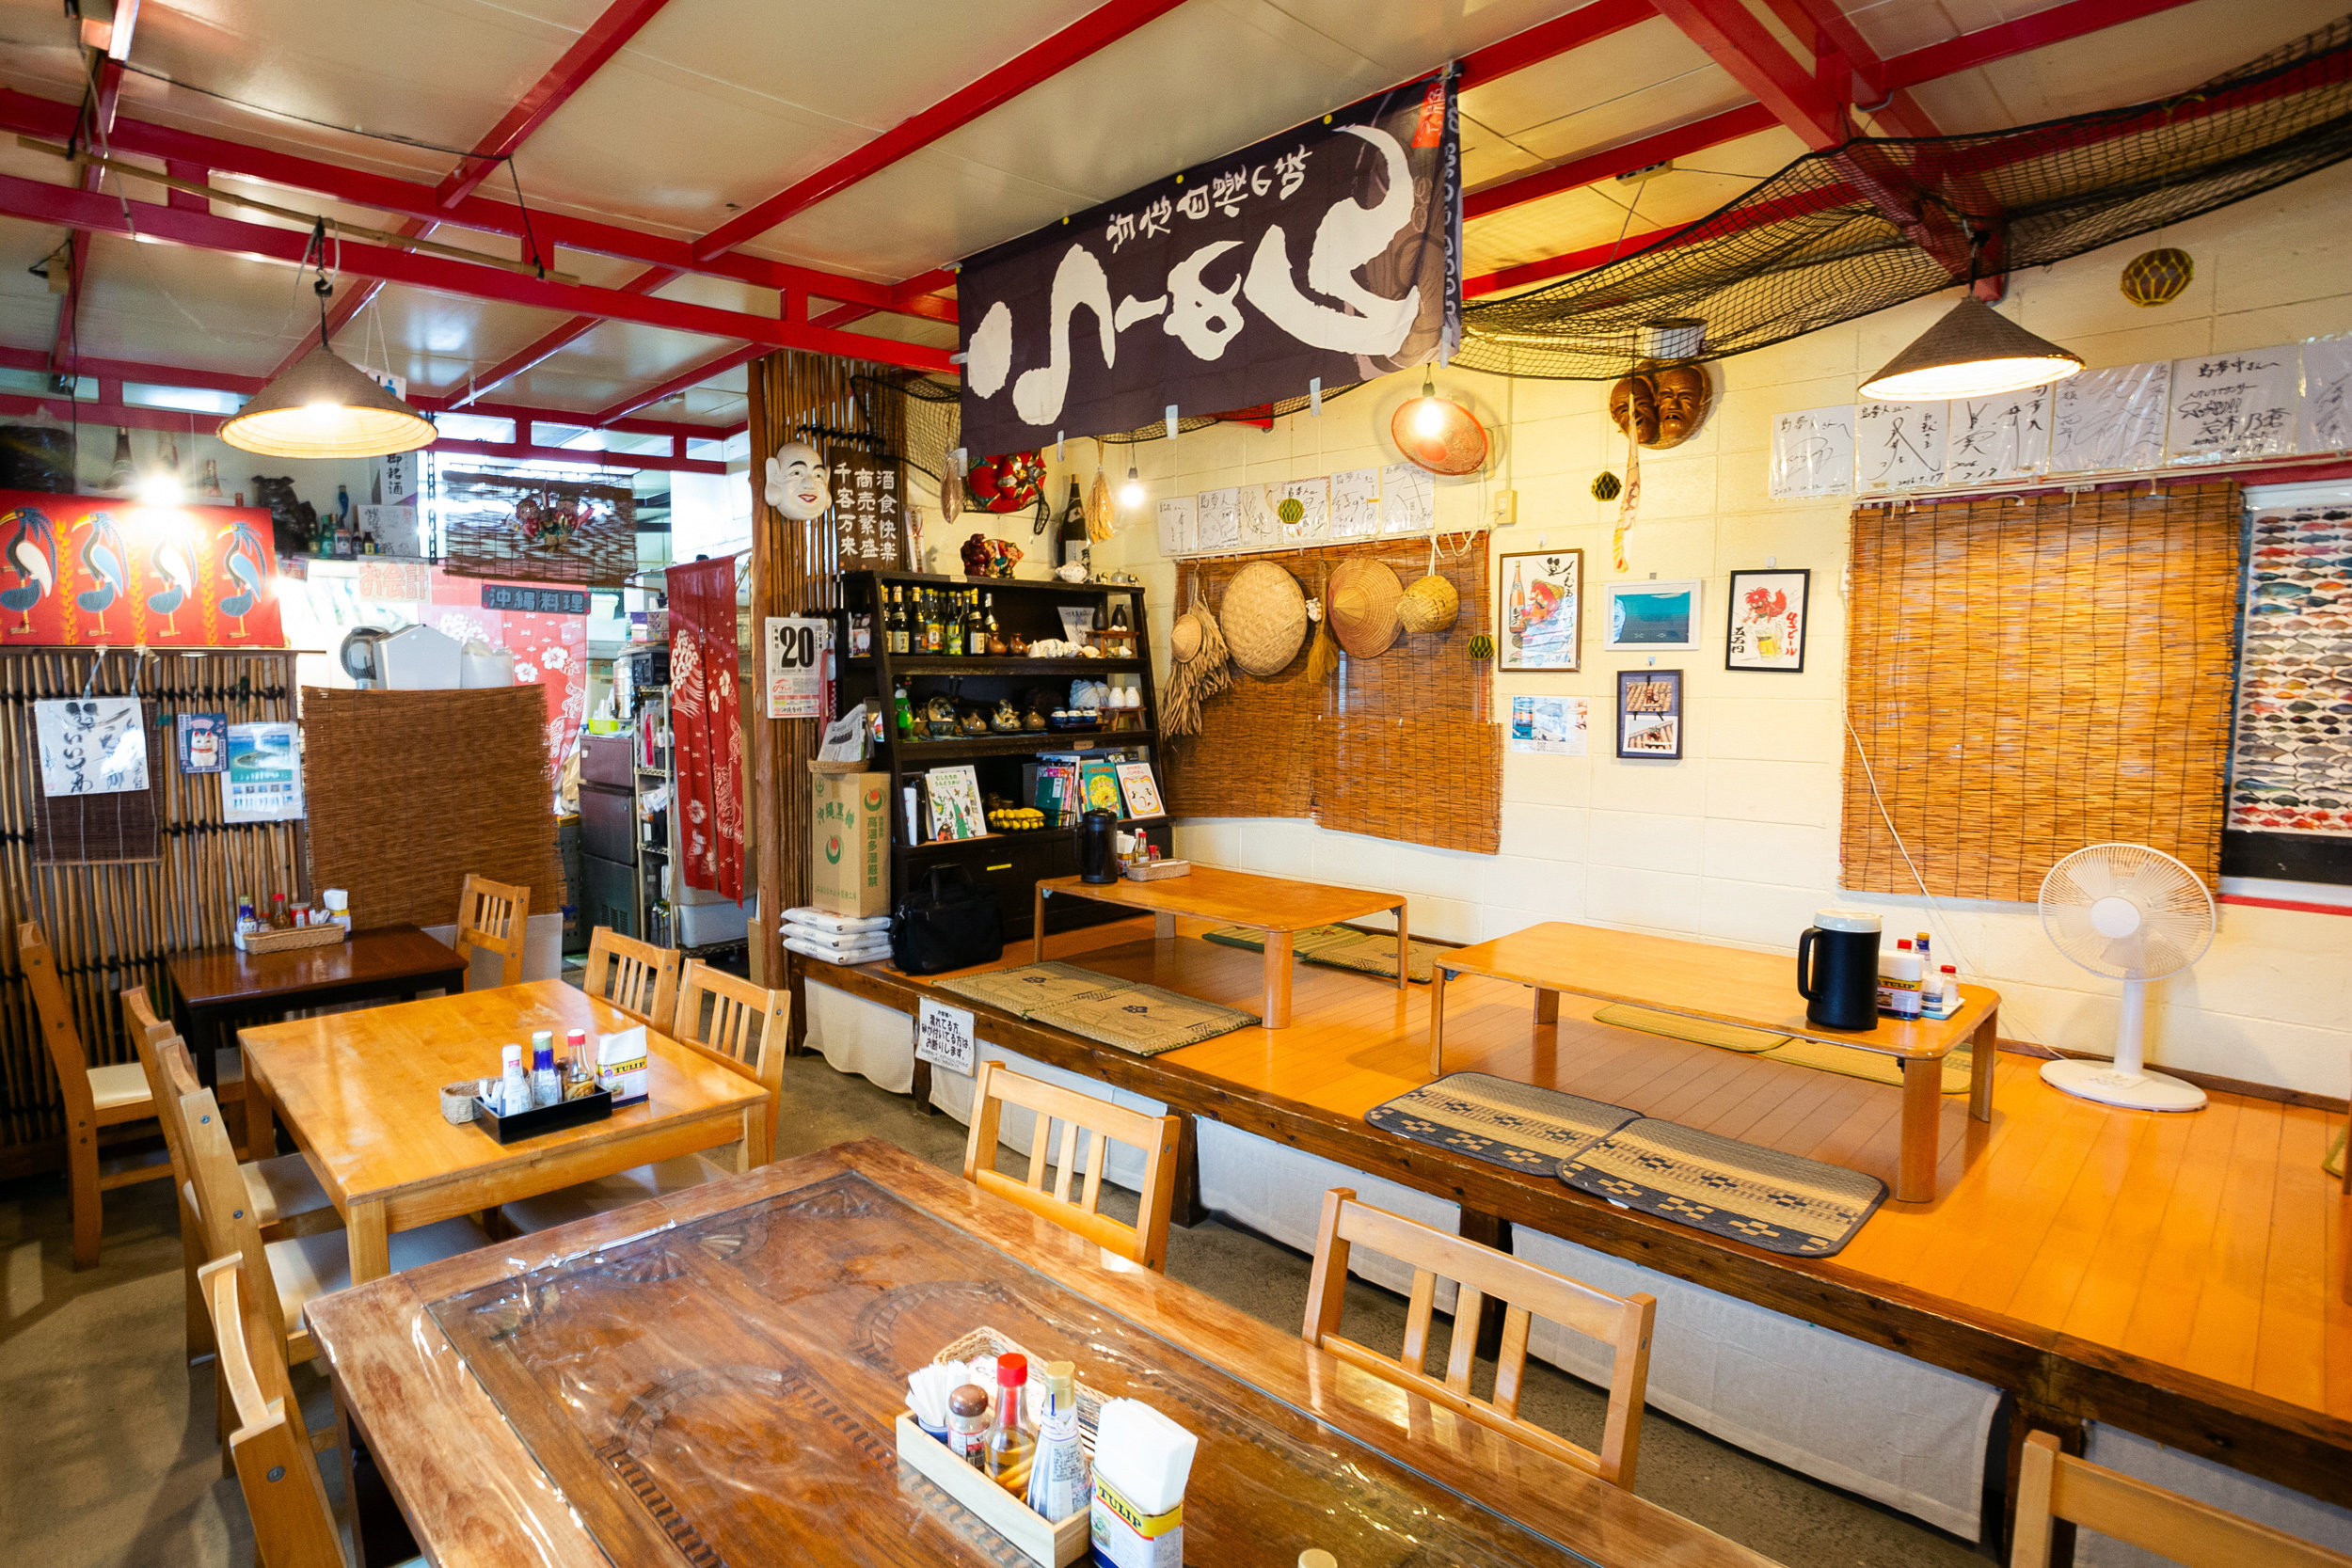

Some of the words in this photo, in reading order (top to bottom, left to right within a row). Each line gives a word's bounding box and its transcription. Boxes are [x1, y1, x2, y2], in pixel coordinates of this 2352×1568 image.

[1105, 144, 1313, 255] 当店自慢の味
[967, 124, 1421, 426] らーめん
[834, 461, 858, 557] 千客万来
[854, 467, 879, 559] 商売繁盛
[876, 470, 898, 562] 酒食快楽
[359, 562, 430, 600] お会計
[490, 588, 584, 613] 沖縄料理
[780, 626, 815, 668] 20
[1883, 980, 1916, 990] TULIP
[614, 1061, 646, 1074] TULIP
[1099, 1485, 1142, 1529] TULIP
